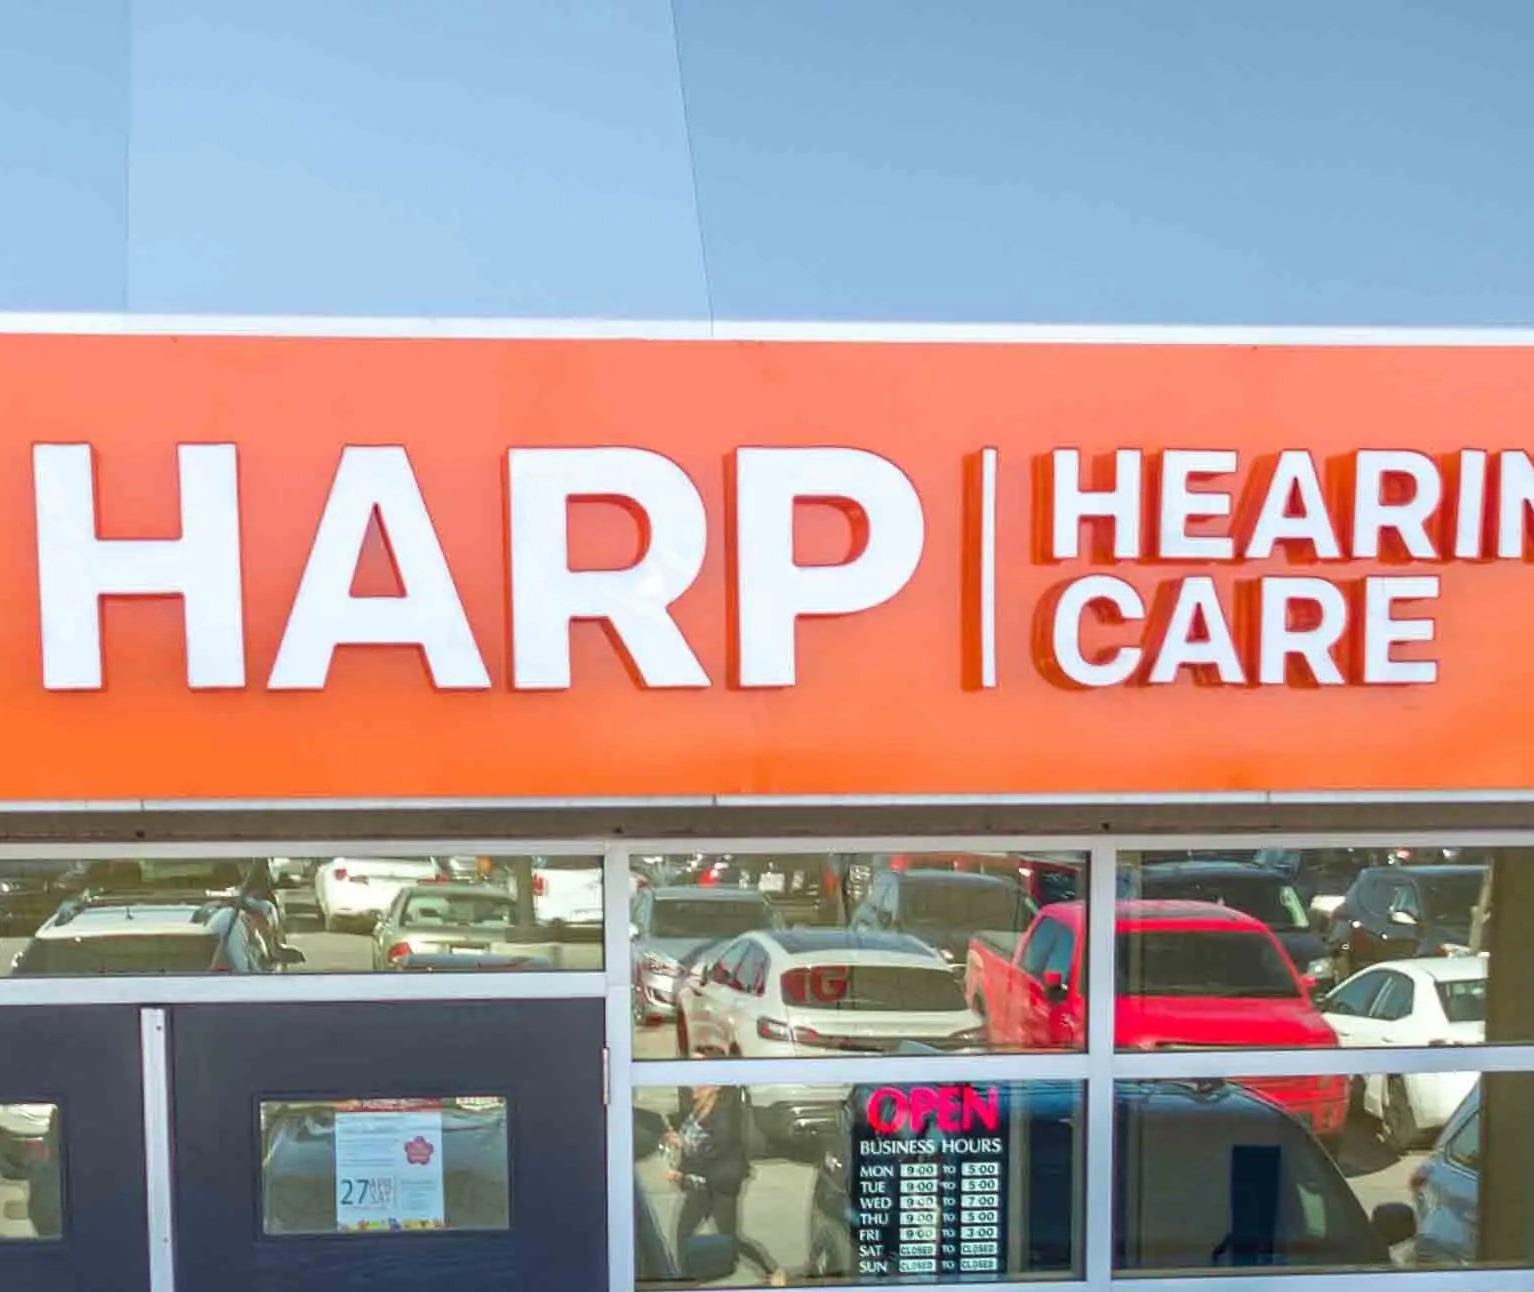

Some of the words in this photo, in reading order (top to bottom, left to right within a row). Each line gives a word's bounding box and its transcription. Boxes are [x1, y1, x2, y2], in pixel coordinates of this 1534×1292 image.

[30, 441, 925, 691] HARP
[1052, 575, 1440, 687] CARE
[867, 1083, 999, 1134] OPEN
[860, 1140, 936, 1155] BUSINESS
[942, 1138, 1001, 1153] HOURS
[860, 1166, 894, 1177] MON
[943, 1165, 956, 1174] TO
[340, 1180, 369, 1205] 27
[860, 1181, 886, 1193] TUE
[942, 1181, 955, 1190] TO
[859, 1197, 892, 1209] WED
[943, 1197, 955, 1206] TO
[859, 1213, 888, 1225] THU
[943, 1213, 955, 1222] TO
[859, 1229, 880, 1240] FRI
[942, 1229, 955, 1238] TO
[859, 1245, 883, 1257] SAT
[941, 1245, 955, 1253] TO
[859, 1261, 888, 1273] SUN
[942, 1261, 955, 1269] TO
